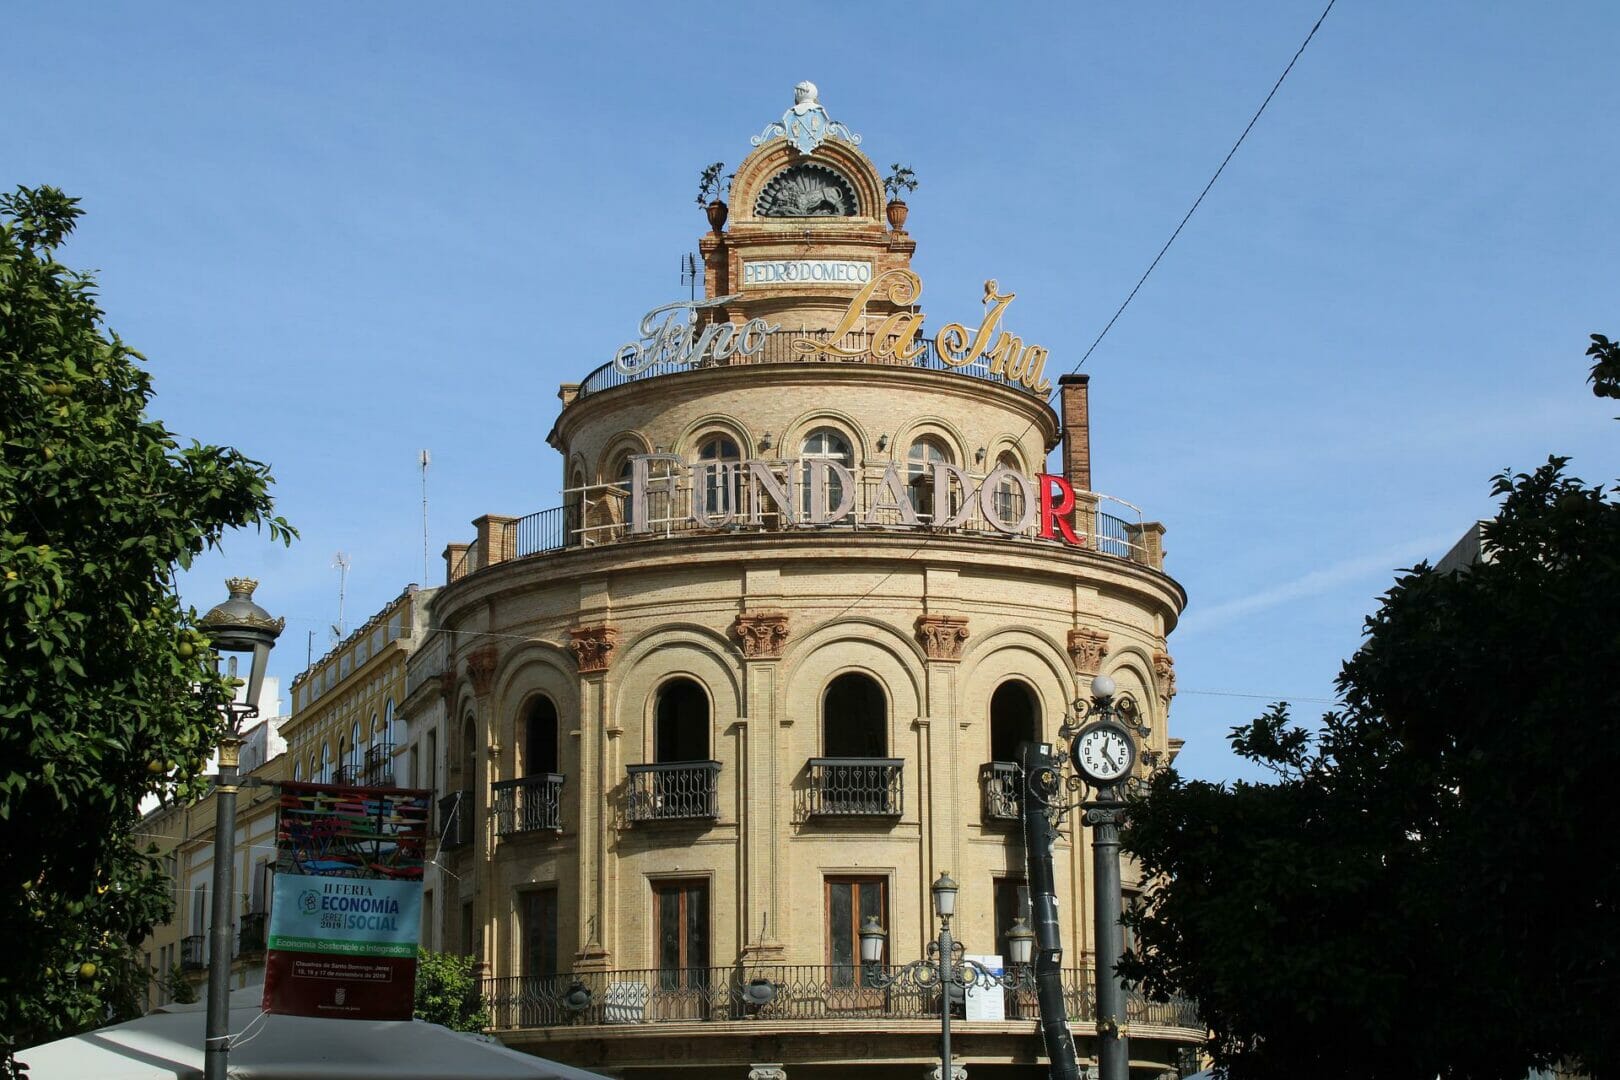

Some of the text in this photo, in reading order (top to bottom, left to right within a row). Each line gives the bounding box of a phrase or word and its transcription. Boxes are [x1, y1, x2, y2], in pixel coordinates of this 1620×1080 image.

[613, 267, 1050, 394] Fino La Ina
[627, 453, 1087, 546] FUNDADOR
[324, 883, 373, 896] II FERIA
[321, 896, 399, 914] ECONOMÍA
[321, 912, 343, 921] JEREZ
[347, 915, 398, 931] SOCIAL
[320, 921, 341, 929] 2019
[366, 944, 411, 955] Integradora
